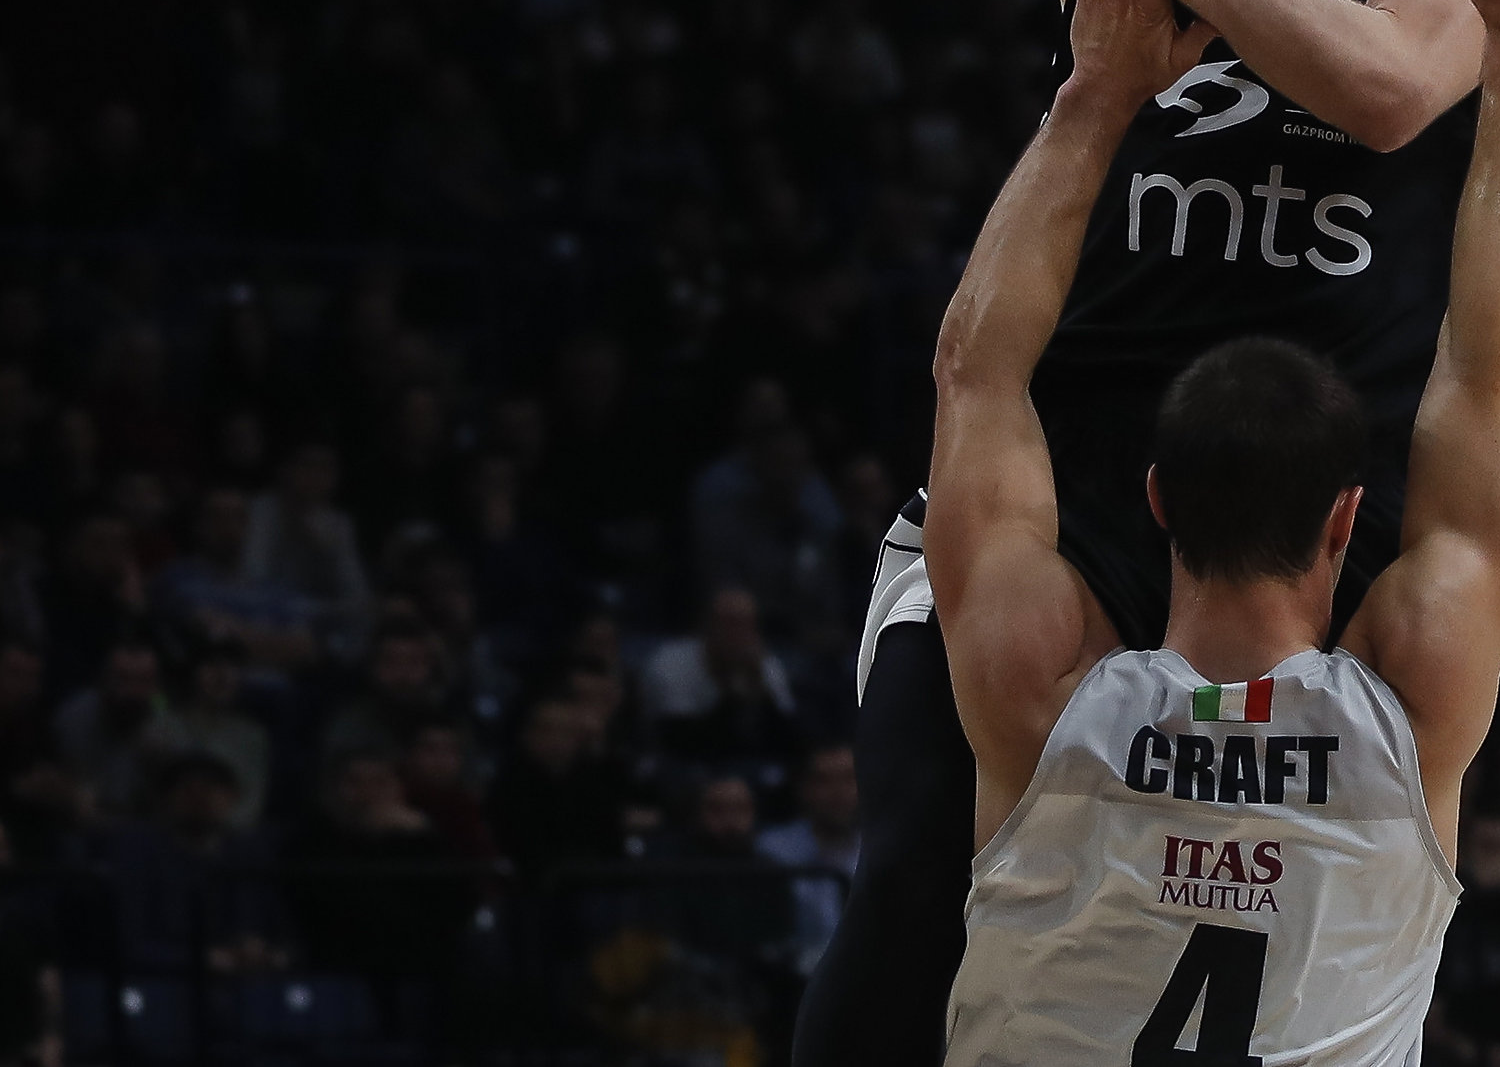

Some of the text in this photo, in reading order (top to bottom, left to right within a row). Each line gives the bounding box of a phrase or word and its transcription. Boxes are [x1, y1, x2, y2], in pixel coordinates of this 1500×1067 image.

[1282, 123, 1345, 143] GAZPROM
[1127, 164, 1373, 276] mts
[1123, 725, 1340, 805] CRAFT
[1160, 834, 1285, 885] ITAS
[1158, 880, 1280, 913] MUTUA
[1131, 922, 1269, 1067] 4
